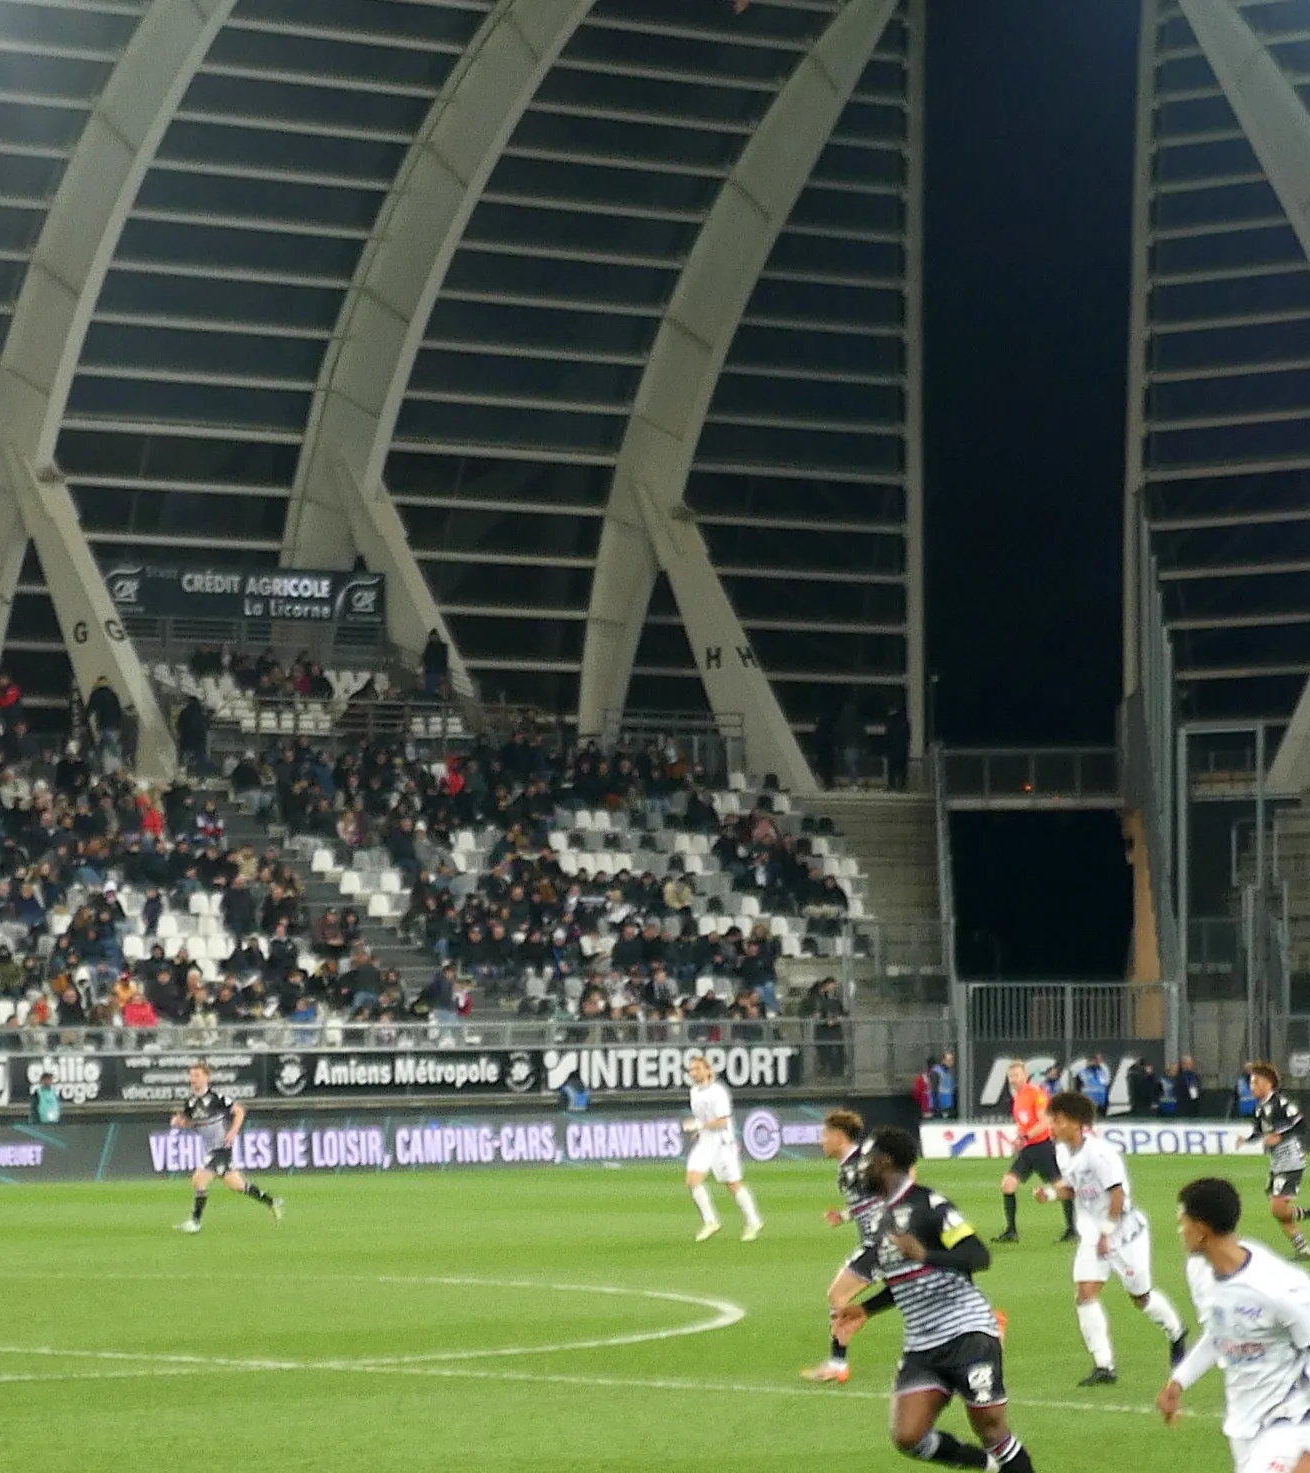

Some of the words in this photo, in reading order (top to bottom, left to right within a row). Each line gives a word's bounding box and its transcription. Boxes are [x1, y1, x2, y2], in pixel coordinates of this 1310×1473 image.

[181, 569, 240, 594] CRÉDIT
[245, 577, 331, 599] AGRICOLE
[244, 599, 264, 618] La
[270, 600, 332, 620] Licorne
[705, 647, 722, 670] H
[313, 1060, 391, 1086] Amiens
[394, 1058, 500, 1088] Métropole
[149, 1128, 273, 1172] VÉHILES
[277, 1131, 308, 1169] DE
[311, 1128, 391, 1168] LOISIR,
[395, 1122, 562, 1166] CAMPING-CARS,
[566, 1119, 683, 1161] CARAVANES
[984, 1128, 1228, 1160] INSPORT
